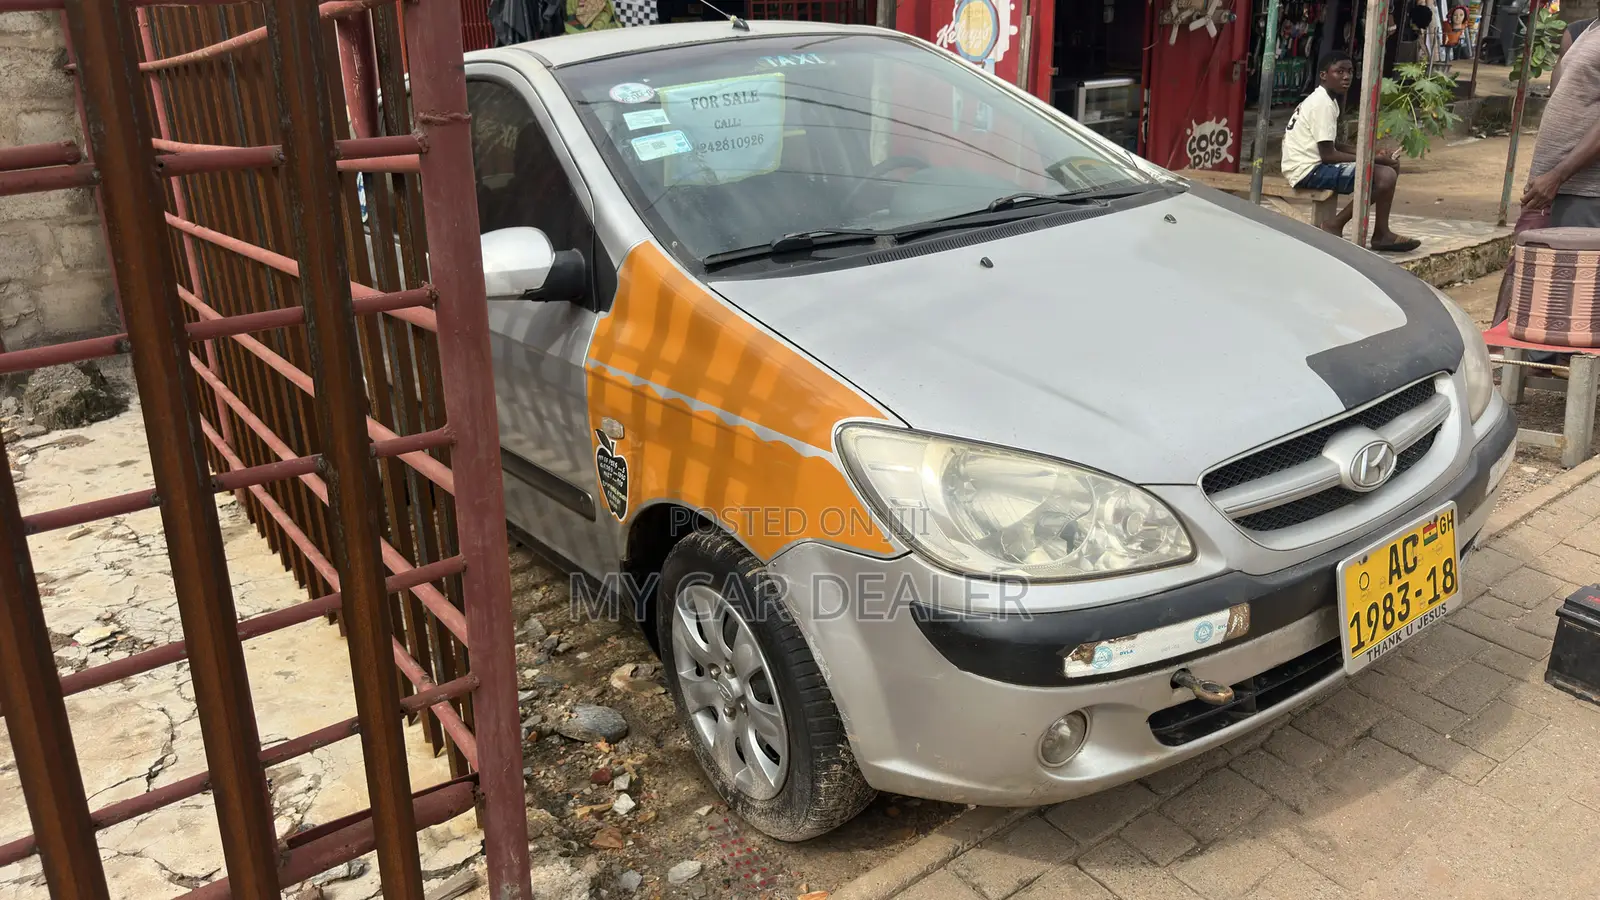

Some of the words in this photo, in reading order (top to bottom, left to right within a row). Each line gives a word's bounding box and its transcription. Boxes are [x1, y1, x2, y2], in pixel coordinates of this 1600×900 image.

[760, 53, 826, 67] TAXI
[690, 95, 719, 110] FOR
[722, 90, 760, 107] SALE
[714, 118, 741, 129] CALL:
[697, 133, 764, 154] 242810926
[1388, 533, 1419, 586] AC
[1439, 509, 1455, 536] GH
[1350, 557, 1455, 653] 1983-18
[1366, 632, 1403, 663] THANK
[1406, 623, 1414, 637] U
[1417, 603, 1447, 630] JESUS
